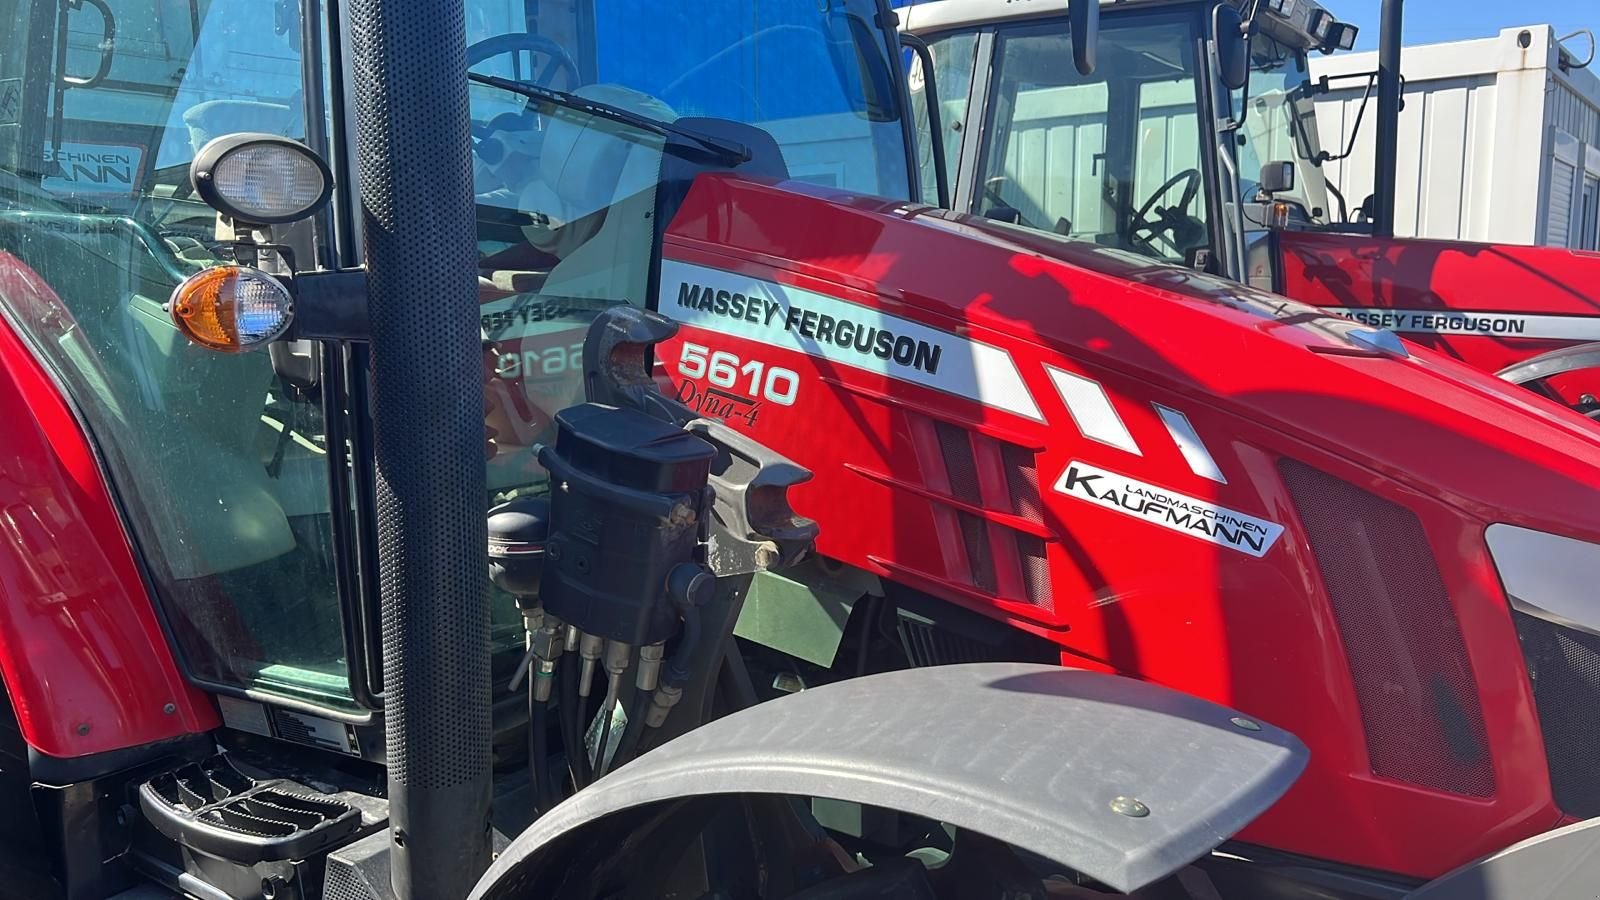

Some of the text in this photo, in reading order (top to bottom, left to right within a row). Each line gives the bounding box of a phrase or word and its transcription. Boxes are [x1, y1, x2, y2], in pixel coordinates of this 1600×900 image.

[677, 282, 942, 375] MASSEY FERGUSON
[1336, 312, 1526, 333] ASSEY FERGUSON
[676, 379, 762, 428] Dyna-4
[678, 341, 800, 407] 5610
[1065, 466, 1265, 552] KAUFMANN
[1125, 484, 1268, 536] LANDMASCHINEN
